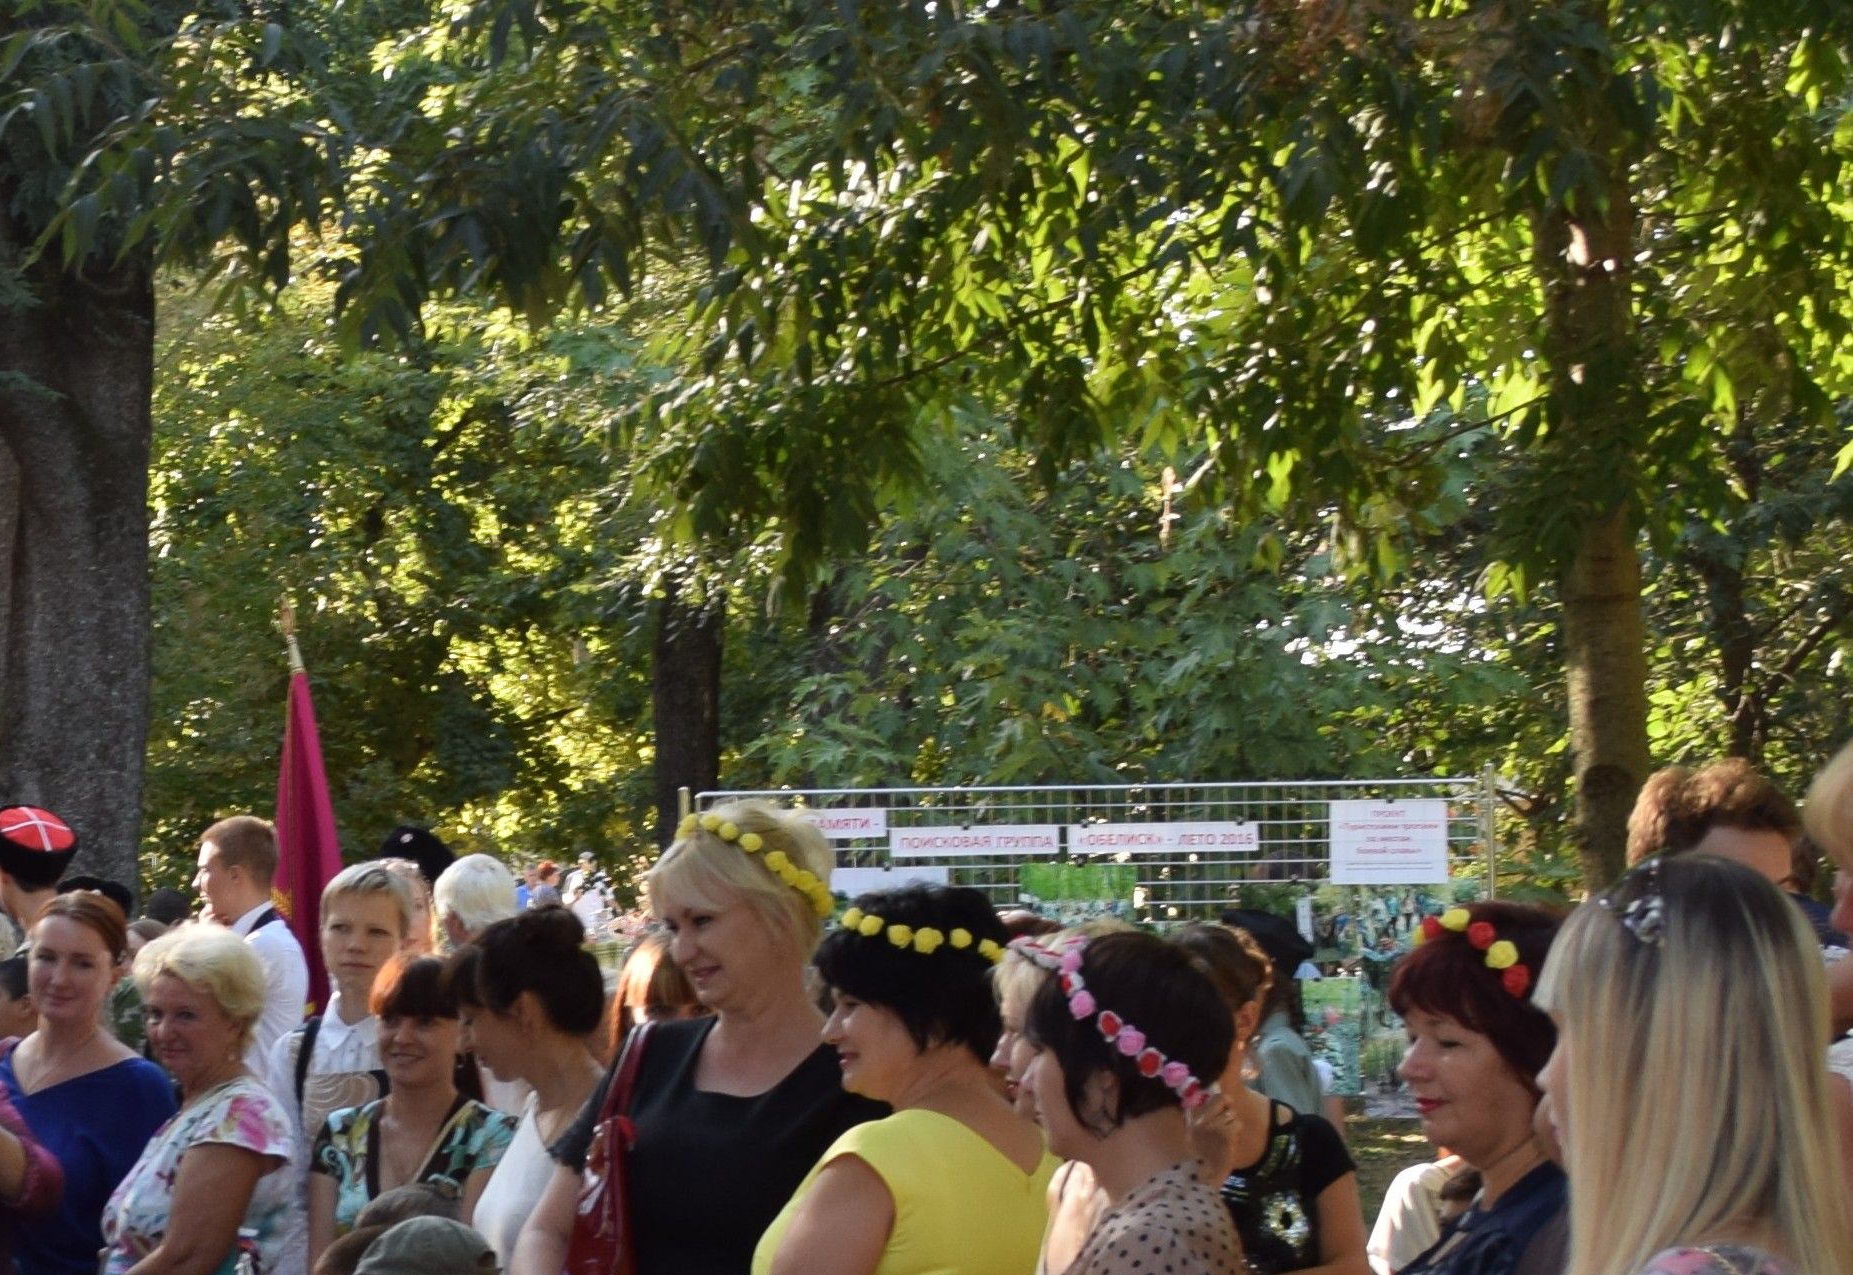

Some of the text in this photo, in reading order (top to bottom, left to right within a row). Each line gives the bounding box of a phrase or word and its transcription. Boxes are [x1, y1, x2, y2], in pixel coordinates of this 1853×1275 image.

[901, 834, 1053, 849] ПОИСКОВАЯ ГРУППА
[1079, 833, 1162, 846] «ОБЕЛИСК»
[1177, 833, 1216, 846] ЛЕТО
[1219, 832, 1254, 845] 2016
